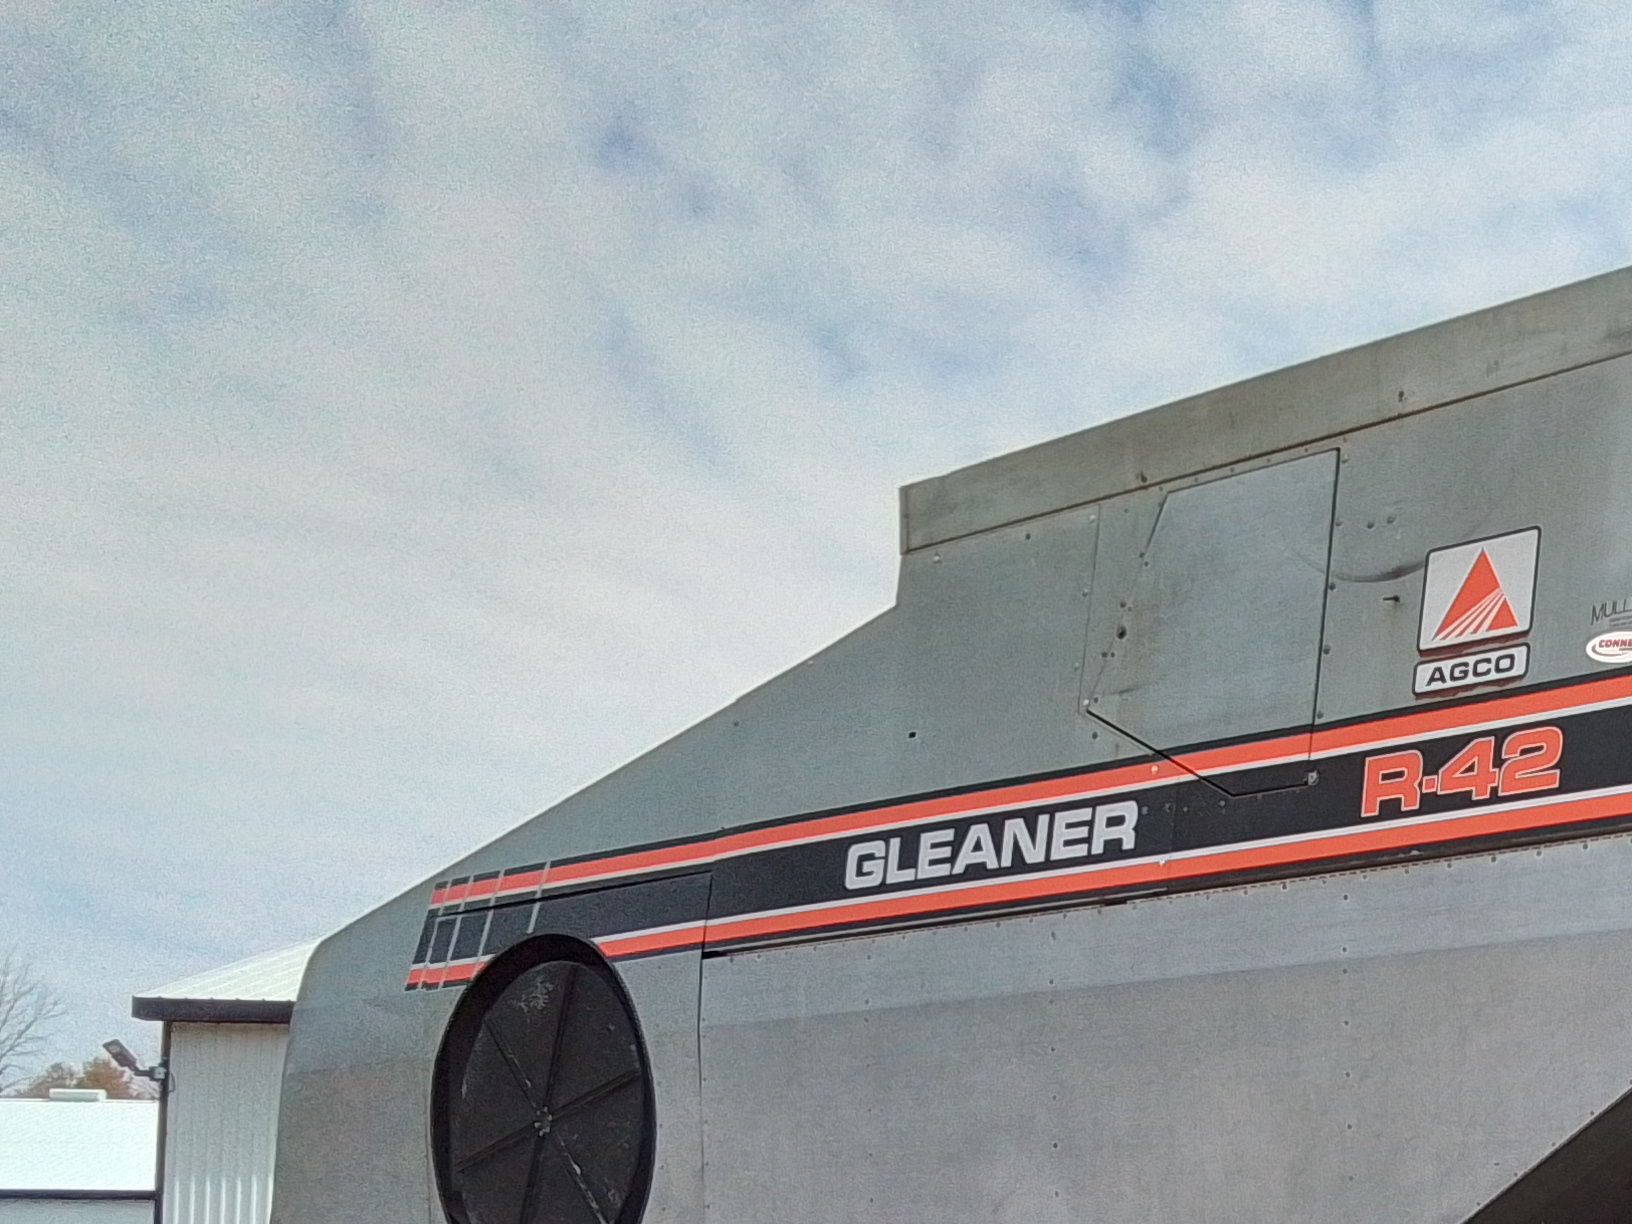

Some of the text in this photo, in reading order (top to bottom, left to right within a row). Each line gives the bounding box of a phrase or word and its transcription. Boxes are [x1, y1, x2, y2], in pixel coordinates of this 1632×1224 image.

[1425, 653, 1516, 688] AGCO
[1360, 726, 1563, 818] R-42
[845, 800, 1139, 890] GLEANER
